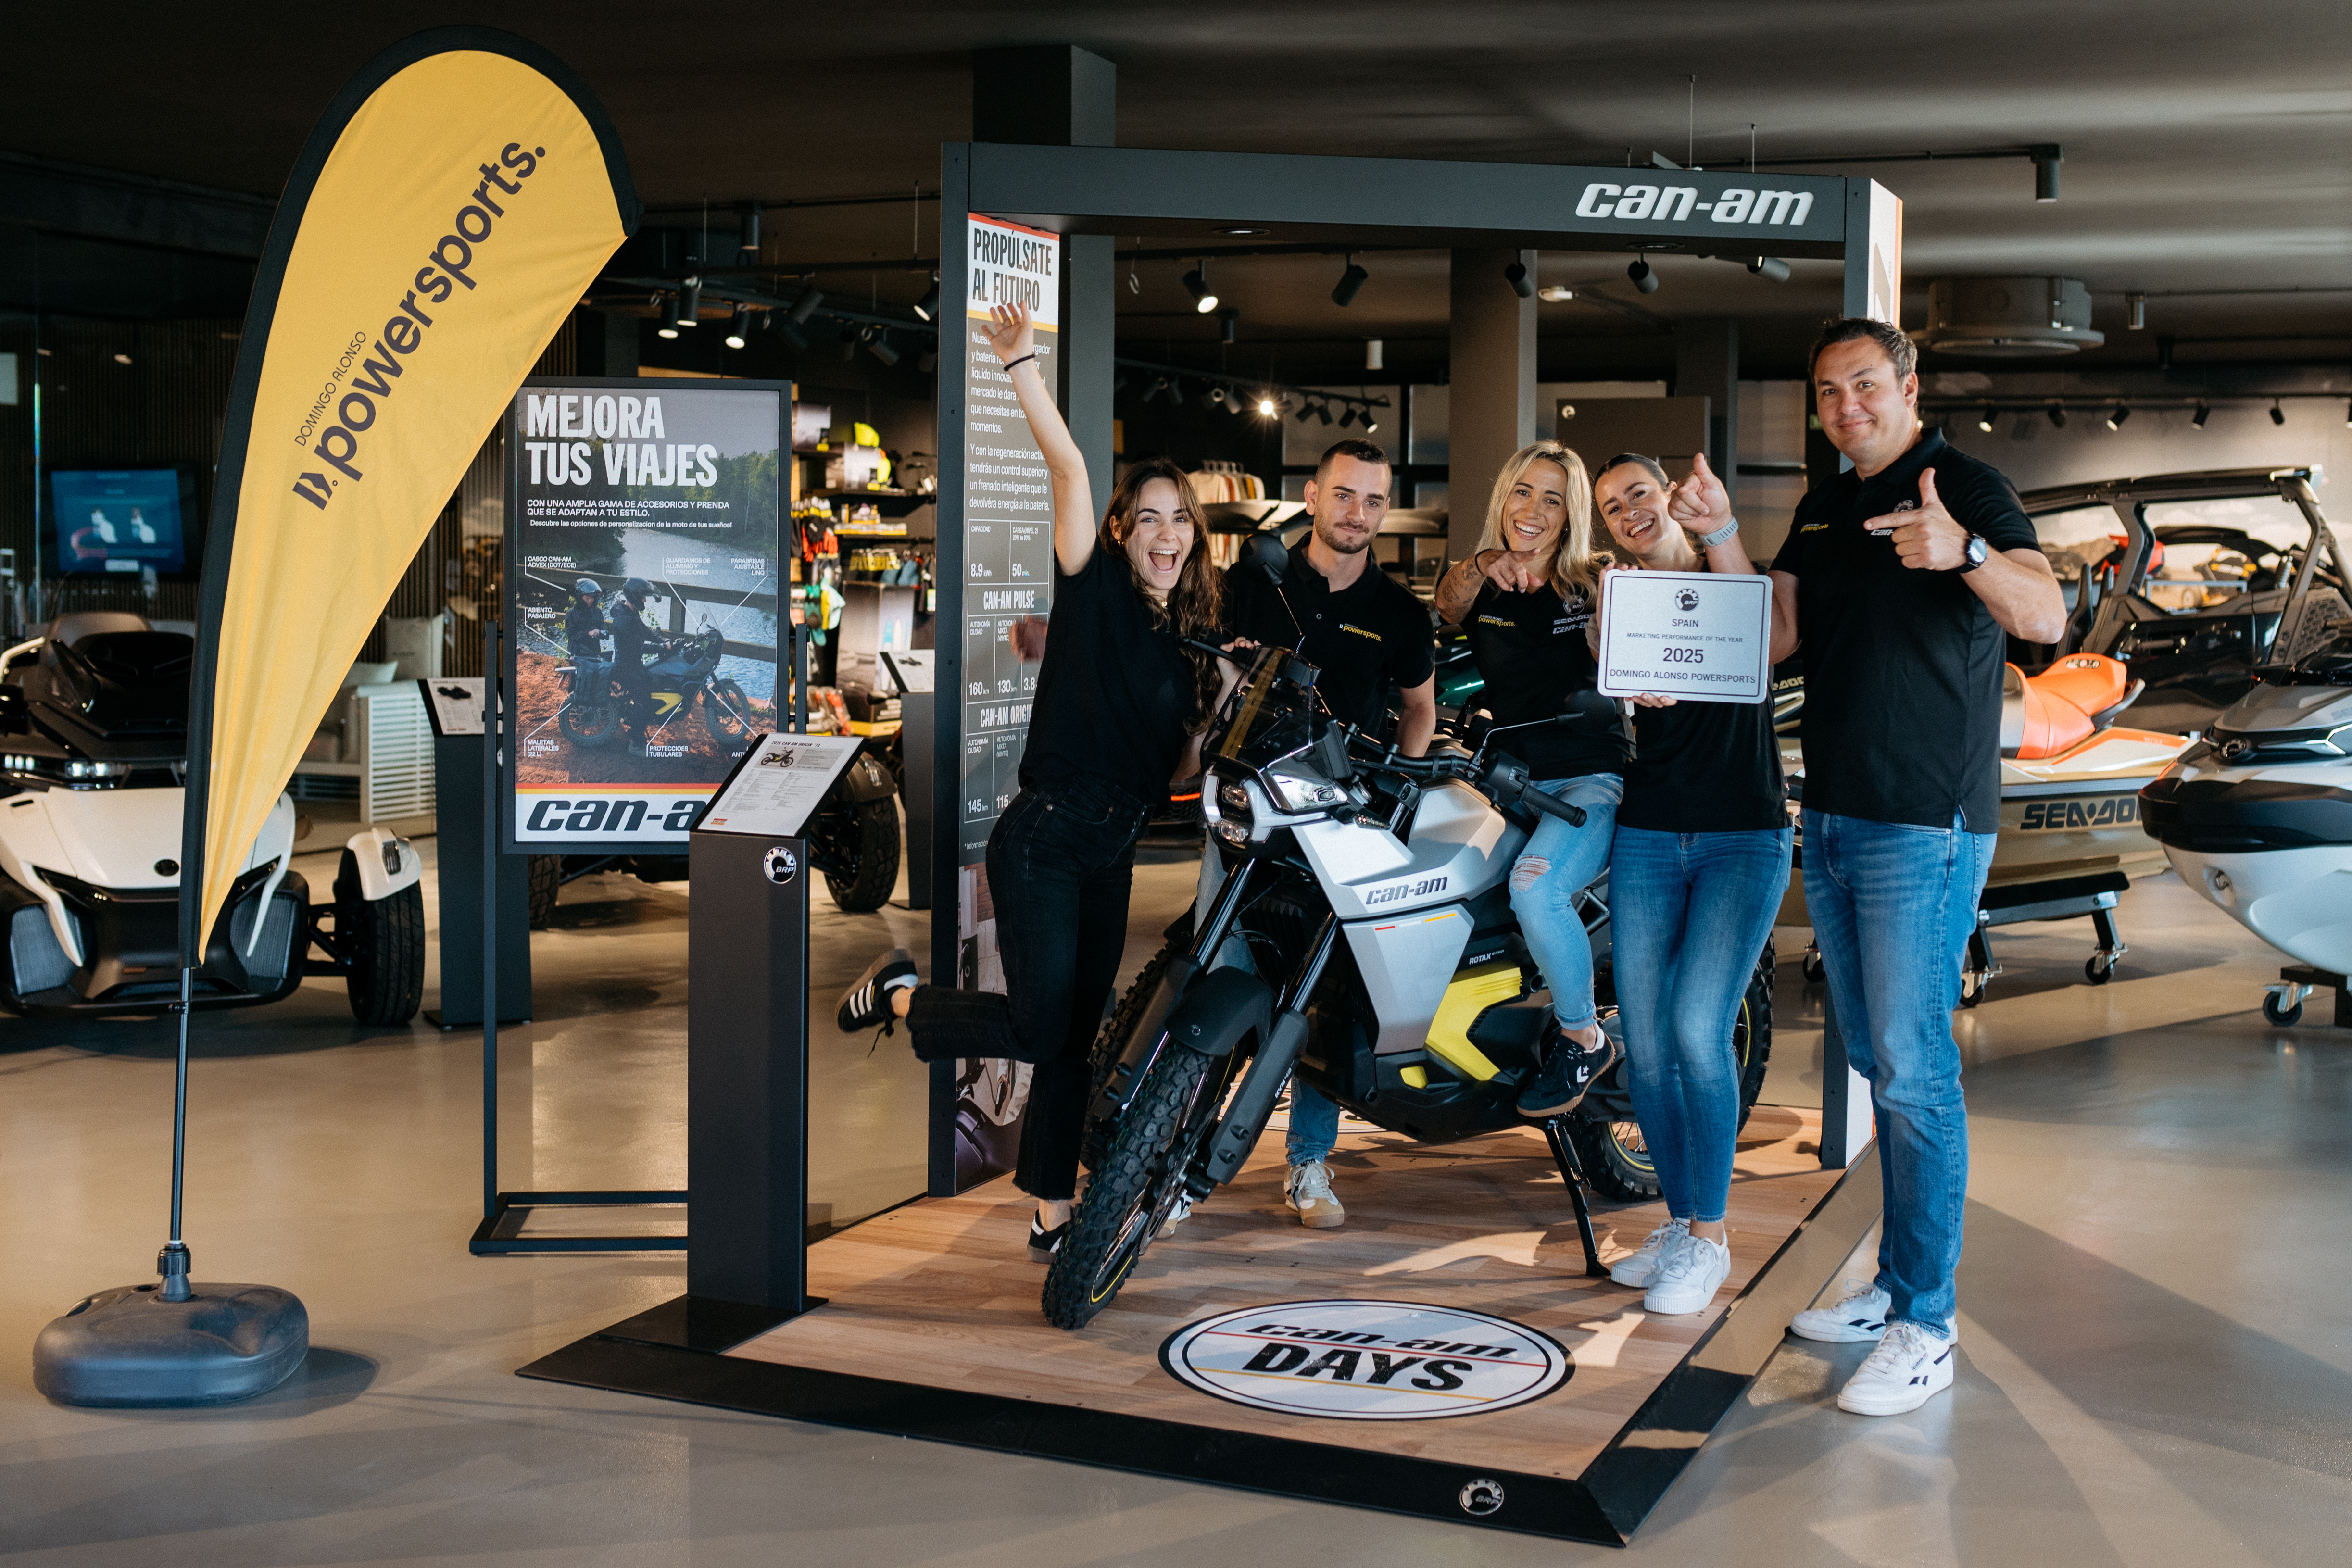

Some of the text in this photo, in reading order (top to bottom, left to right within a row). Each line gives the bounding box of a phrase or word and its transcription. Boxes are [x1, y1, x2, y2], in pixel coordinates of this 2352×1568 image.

[1575, 183, 1814, 226] can-am
[974, 228, 1052, 276] PROPÚLSATE
[972, 268, 1040, 312] AL FUTURO
[314, 142, 546, 482] powersports.
[1032, 343, 1051, 355] rgador
[971, 351, 975, 363] y
[976, 350, 996, 364] bateria
[971, 367, 991, 381] liquido
[294, 331, 366, 447] DOMINGO ALONSO
[971, 387, 1017, 401] mercado le dara
[527, 395, 665, 439] MEJORA
[970, 404, 982, 415] que
[983, 405, 1010, 417] necesitas
[1010, 408, 1018, 418] en
[970, 422, 1003, 433] momentos.
[970, 443, 975, 455] Y
[975, 446, 986, 456] con
[987, 445, 993, 456] la
[994, 448, 1030, 460] regeneración
[525, 442, 717, 487] TUS VIAJES
[970, 462, 1048, 480] tendrás un control superior y
[969, 479, 1047, 496] un frenado inteligente que le
[566, 500, 597, 508] AMPLIA
[637, 501, 688, 509] ACCESORIOS
[697, 501, 730, 509] PRENDA
[969, 496, 1049, 512] devolvéra energía a la batería.
[620, 509, 650, 517] ESTILO.
[971, 563, 983, 577] 8.9
[1012, 563, 1022, 577] 50
[983, 590, 1034, 610] CAN-AM PULSE
[970, 619, 991, 628] AUTONOMÍA
[1553, 622, 1587, 634] can-a
[1672, 619, 1699, 627] SPAIN
[1663, 648, 1704, 663] 2025
[1024, 677, 1035, 691] 3.8
[1610, 669, 1756, 684] DOMINGO ALONSO POWERSPORTS
[969, 681, 983, 696] 160
[997, 679, 1011, 693] 130
[980, 706, 1009, 728] CAN-AM
[968, 737, 989, 746] AUTONOMÍA
[997, 734, 1016, 743] AUTONOMÍA
[968, 799, 981, 814] 145
[996, 794, 1009, 809] 115
[526, 800, 707, 831] can-a
[1366, 876, 1448, 905] can-am
[1469, 953, 1491, 965] ROTAX
[1246, 1324, 1518, 1359] can-am
[1242, 1342, 1472, 1391] DAYS
[1475, 1495, 1500, 1505] BRP
